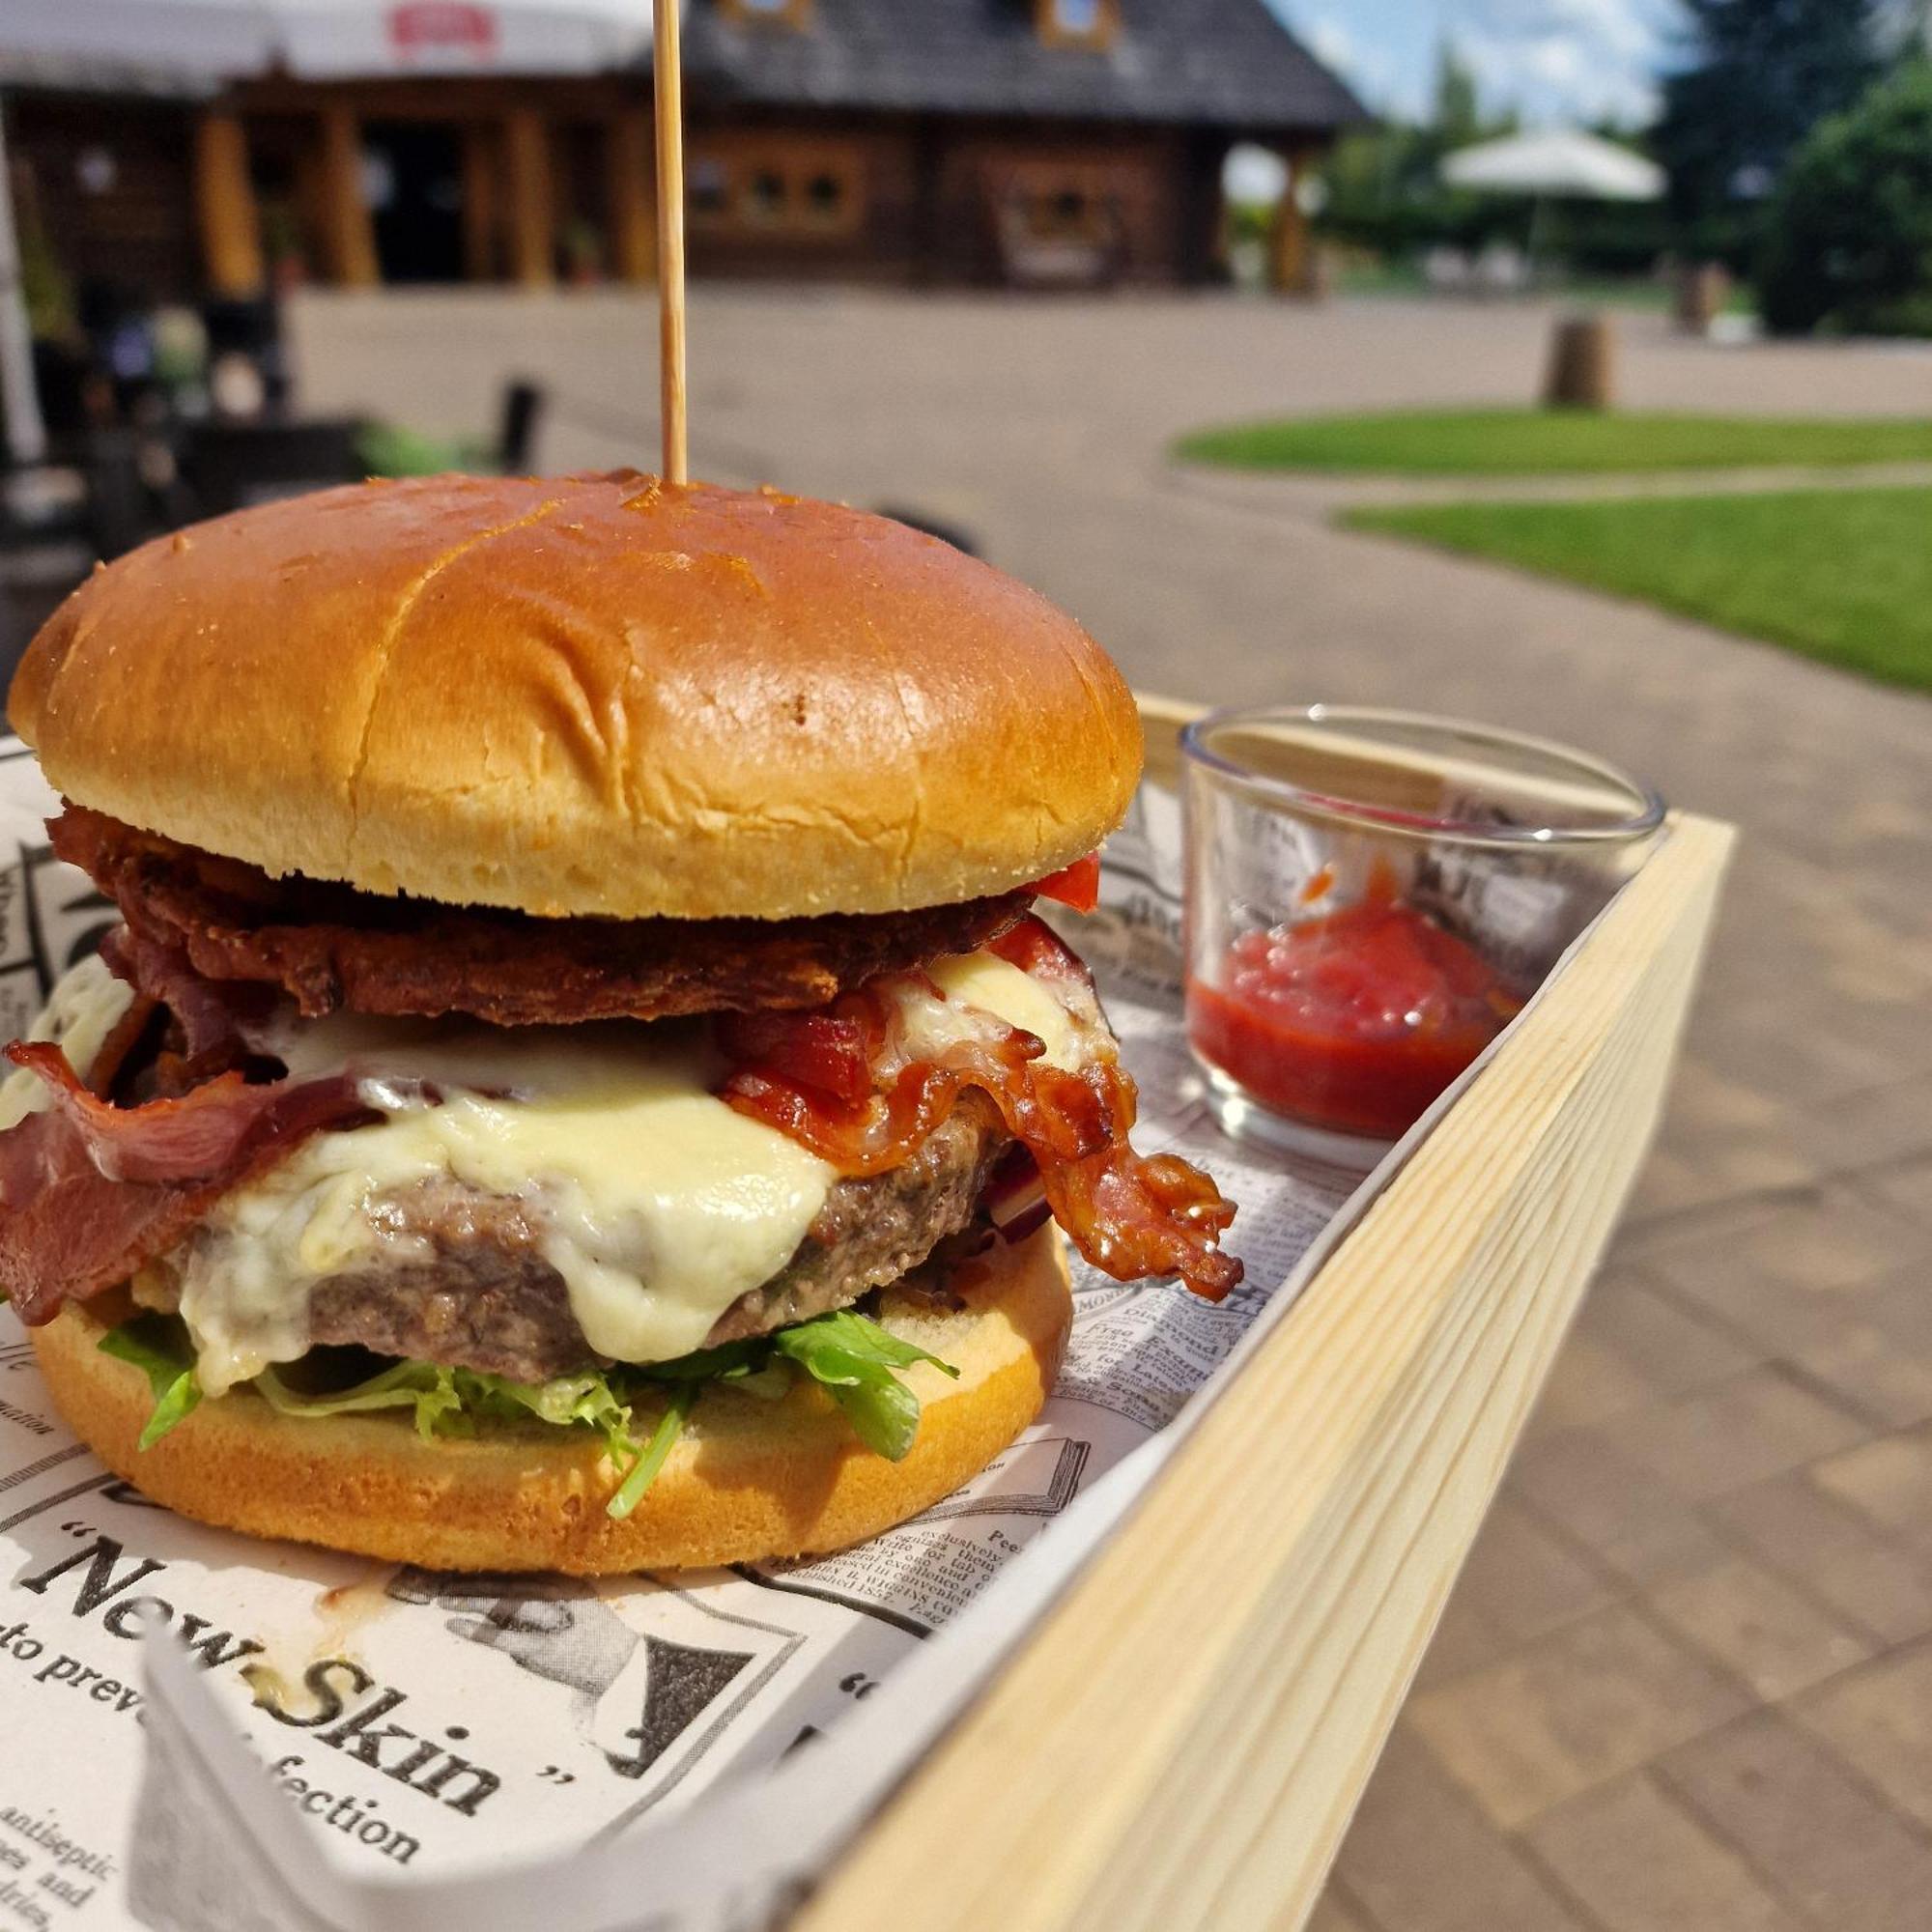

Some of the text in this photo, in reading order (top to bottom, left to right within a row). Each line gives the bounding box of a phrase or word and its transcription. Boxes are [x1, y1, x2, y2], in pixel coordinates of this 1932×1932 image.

[1087, 1321, 1134, 1336] Free
[1123, 1308, 1220, 1355] Diamond
[33, 1653, 152, 1729] prev
[240, 1732, 421, 1865] fection
[239, 1658, 501, 1818] Skin
[36, 1872, 96, 1910] and
